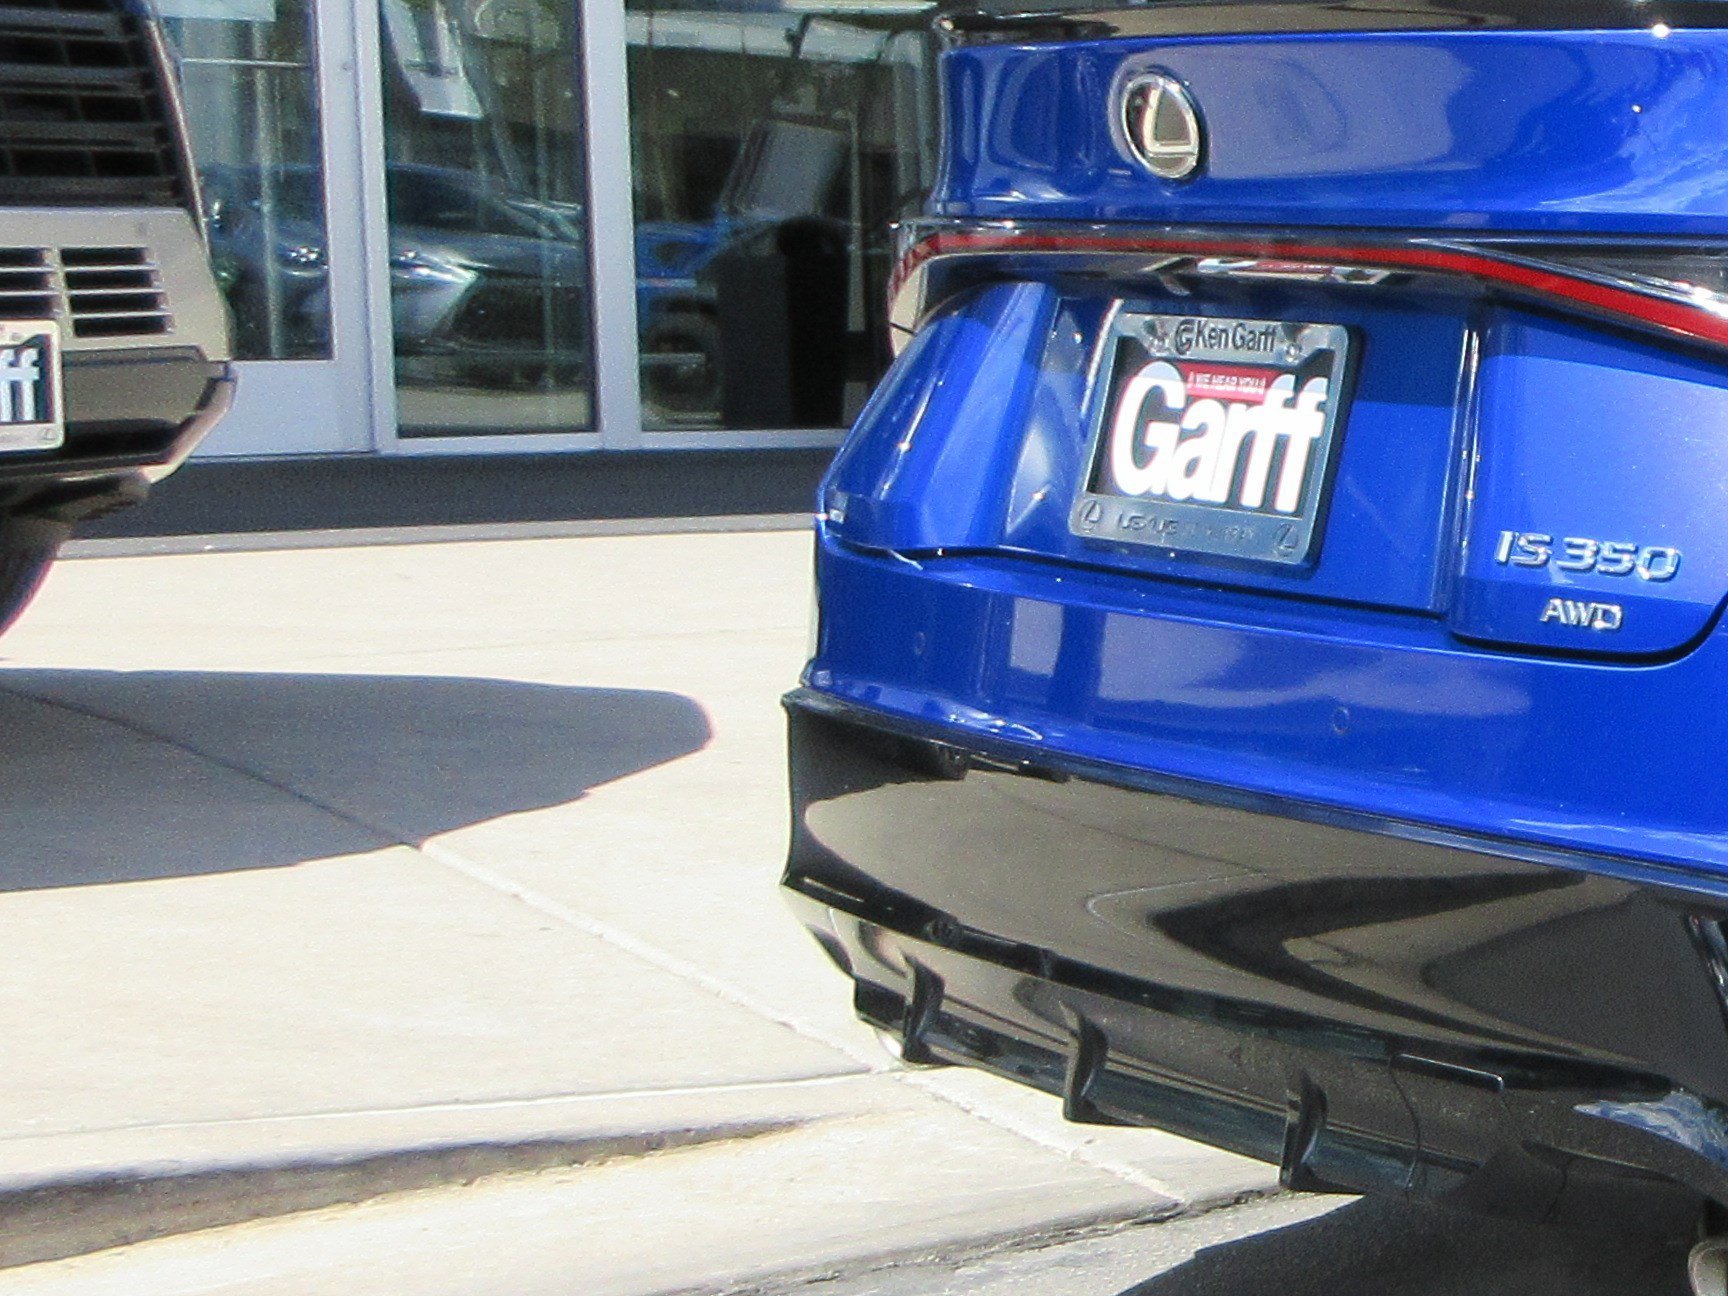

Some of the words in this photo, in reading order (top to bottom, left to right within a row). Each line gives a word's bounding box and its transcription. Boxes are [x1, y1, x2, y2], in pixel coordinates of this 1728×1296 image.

[1195, 319, 1229, 349] Ken
[1232, 322, 1276, 352] Garff
[0, 347, 40, 422] ff
[1112, 360, 1328, 513] Garff
[1495, 530, 1553, 567] IS
[1556, 537, 1680, 582] 350
[1540, 597, 1623, 630] AWD
